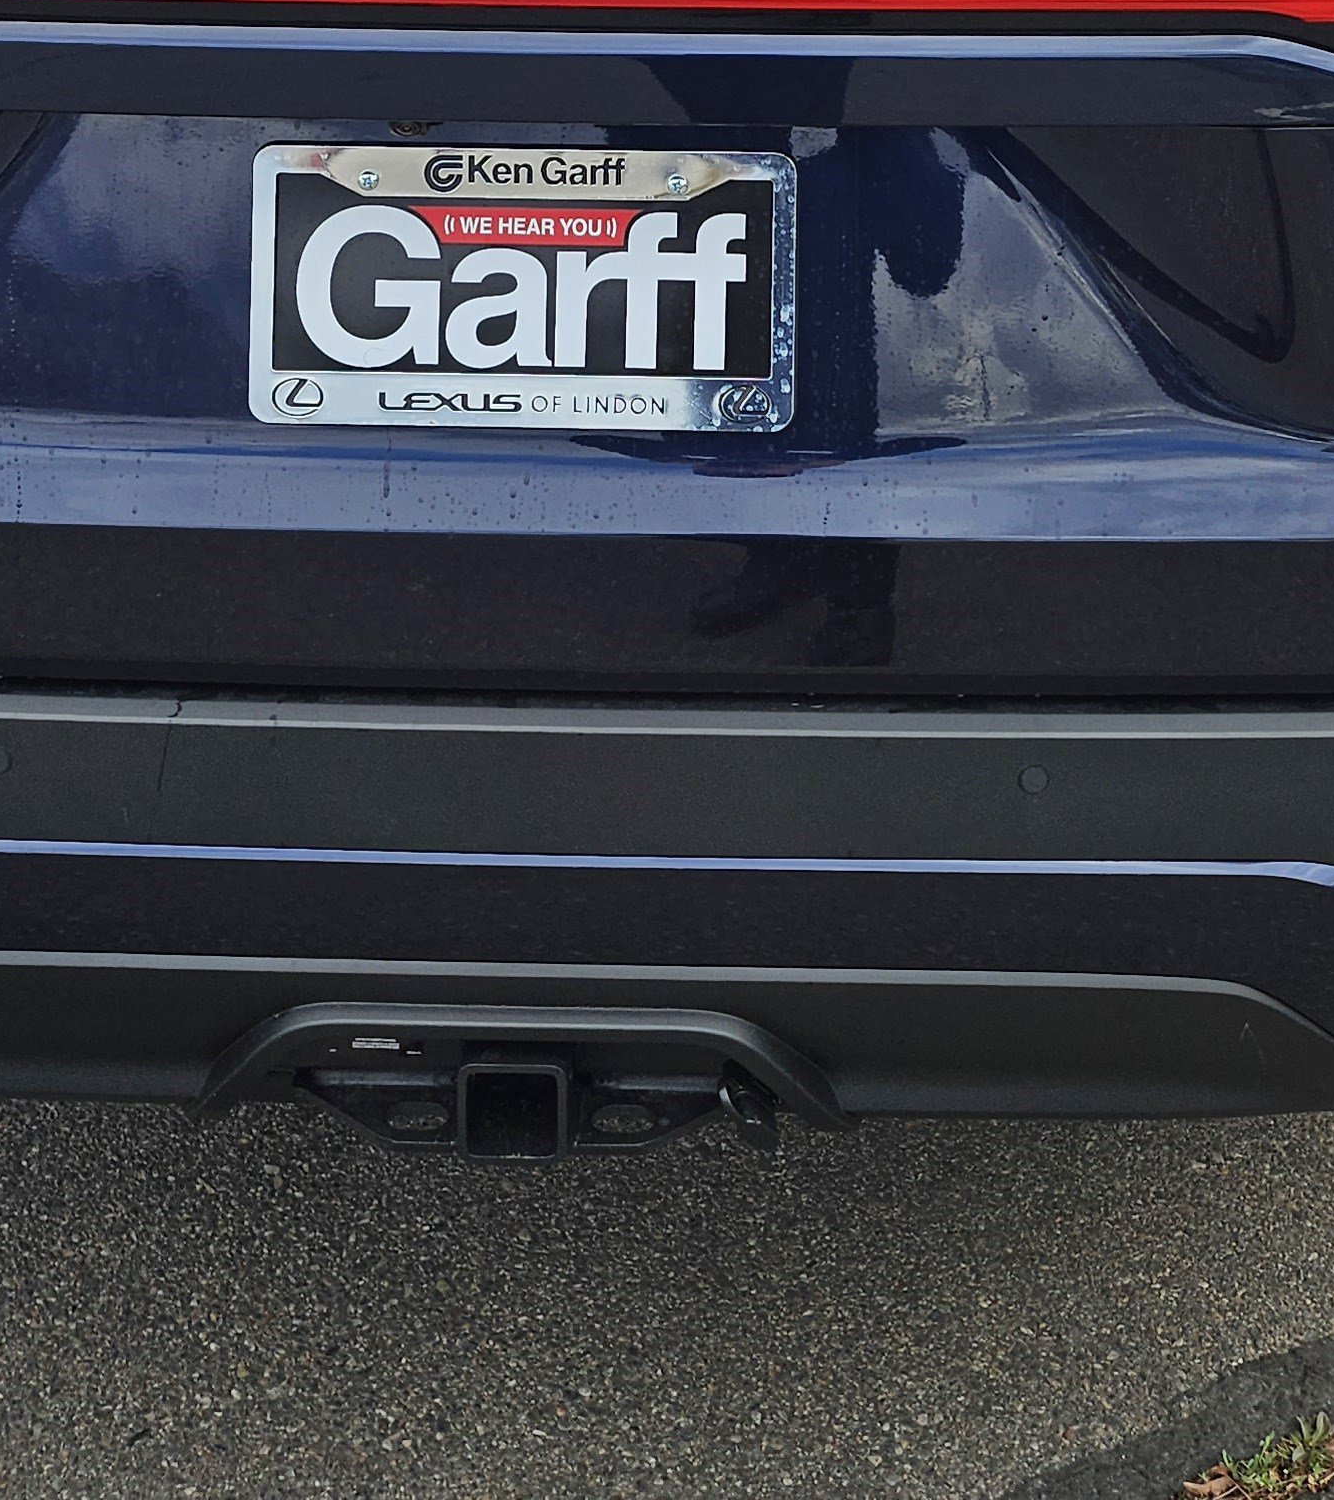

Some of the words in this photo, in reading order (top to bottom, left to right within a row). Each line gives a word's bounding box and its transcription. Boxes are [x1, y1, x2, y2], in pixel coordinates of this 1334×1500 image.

[468, 155, 533, 184] Ken
[541, 156, 626, 186] Garff
[460, 216, 493, 235] WE
[498, 217, 555, 236] HEAR
[559, 218, 603, 237] YOU
[295, 204, 747, 372] Garff
[378, 391, 523, 413] LEXUS
[531, 395, 562, 413] OF
[573, 396, 668, 415] LINDON
